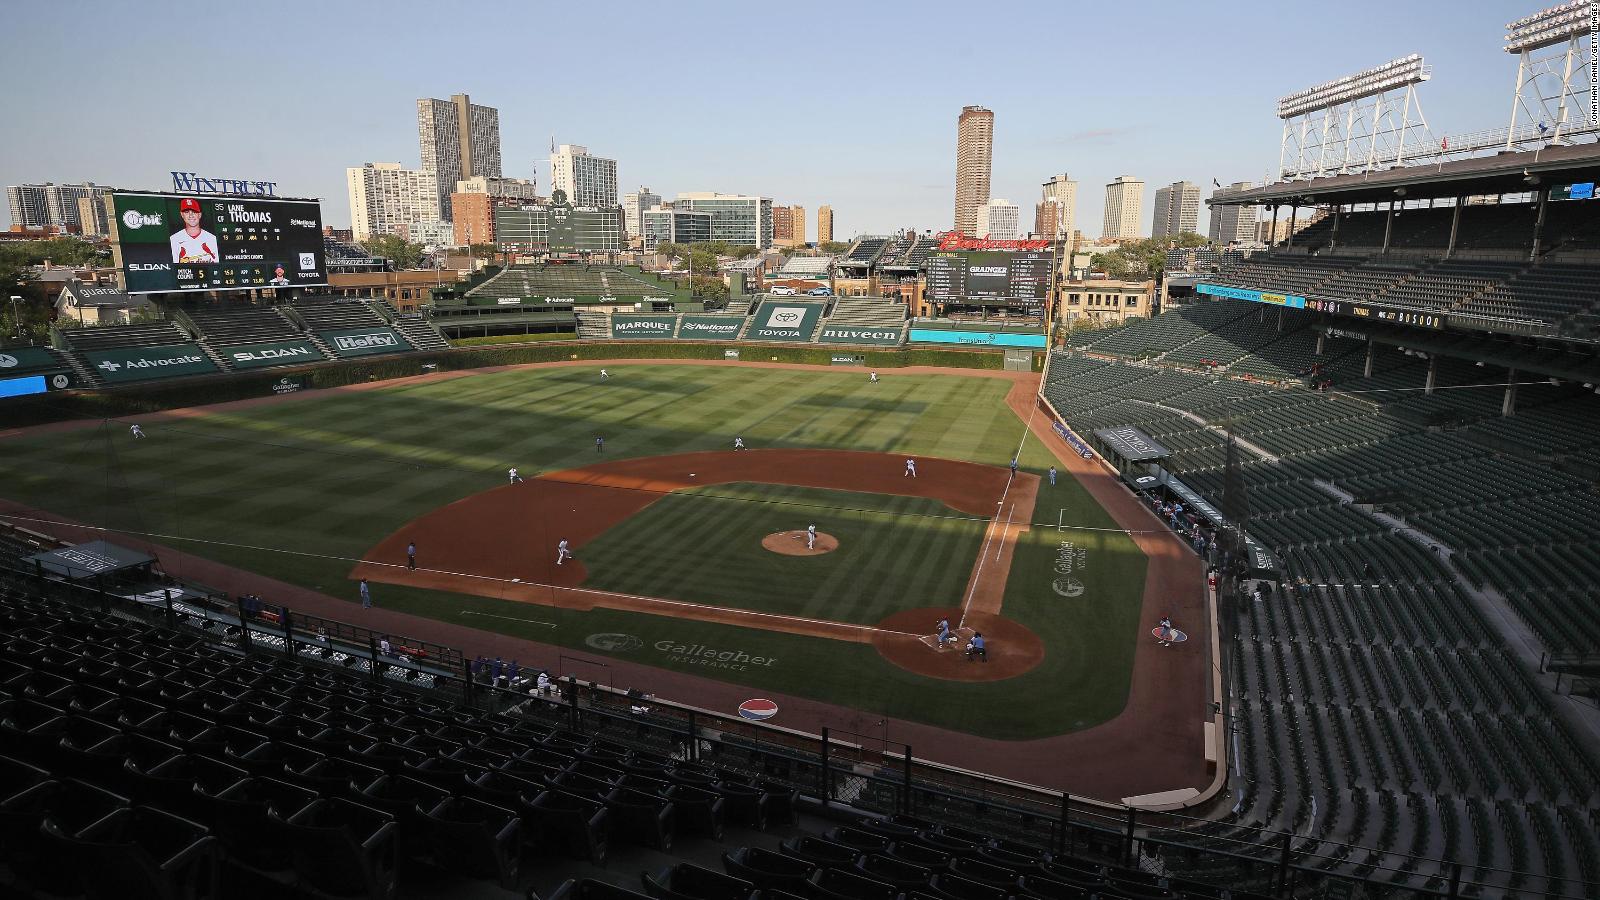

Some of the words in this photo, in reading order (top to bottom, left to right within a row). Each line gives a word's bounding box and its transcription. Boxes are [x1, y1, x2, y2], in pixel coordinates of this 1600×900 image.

[171, 171, 277, 196] WINTRUST
[214, 203, 224, 211] 35
[228, 204, 245, 212] LANE
[123, 209, 163, 230] Orbit
[217, 215, 225, 223] CF
[228, 211, 272, 223] THOMAS
[128, 263, 169, 271] SLOAN
[199, 270, 204, 278] 5
[1323, 302, 1328, 311] 2
[1412, 314, 1417, 324] S
[615, 321, 672, 331] MARQUEE
[758, 329, 800, 337] TOYOTA
[823, 329, 896, 340] nuveen
[338, 333, 392, 349] Hefty
[233, 346, 309, 362] SLOAN
[126, 354, 202, 369] Advocate
[272, 382, 300, 392] Gallagher
[1054, 541, 1077, 574] Gallagher
[654, 640, 779, 667] Gallagher
[667, 654, 748, 672] INSURANCE
